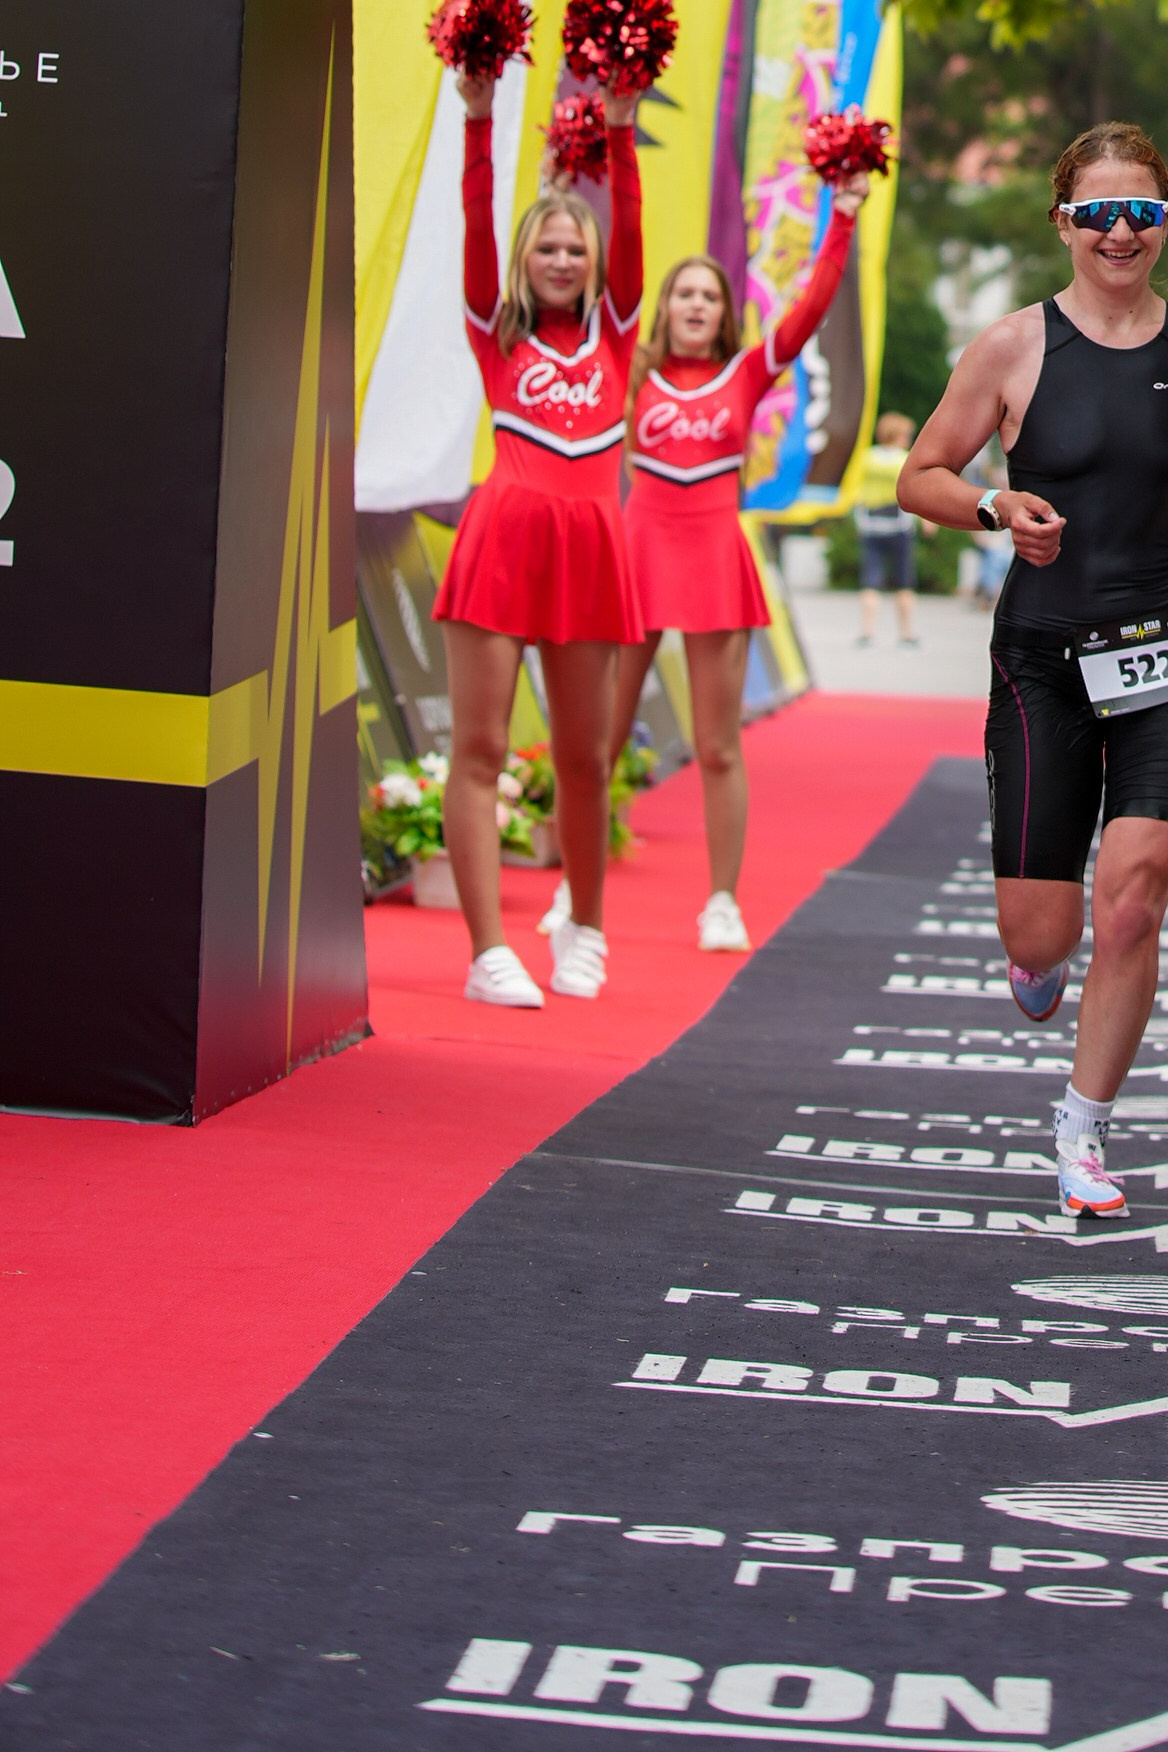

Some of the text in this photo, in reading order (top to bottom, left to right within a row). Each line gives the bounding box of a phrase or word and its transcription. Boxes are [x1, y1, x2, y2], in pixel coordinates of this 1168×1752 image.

[516, 360, 604, 409] Cool
[636, 400, 732, 447] Cool
[734, 1189, 1079, 1234] IRON
[631, 1352, 1071, 1408] IRON
[444, 1637, 1053, 1736] IRON
